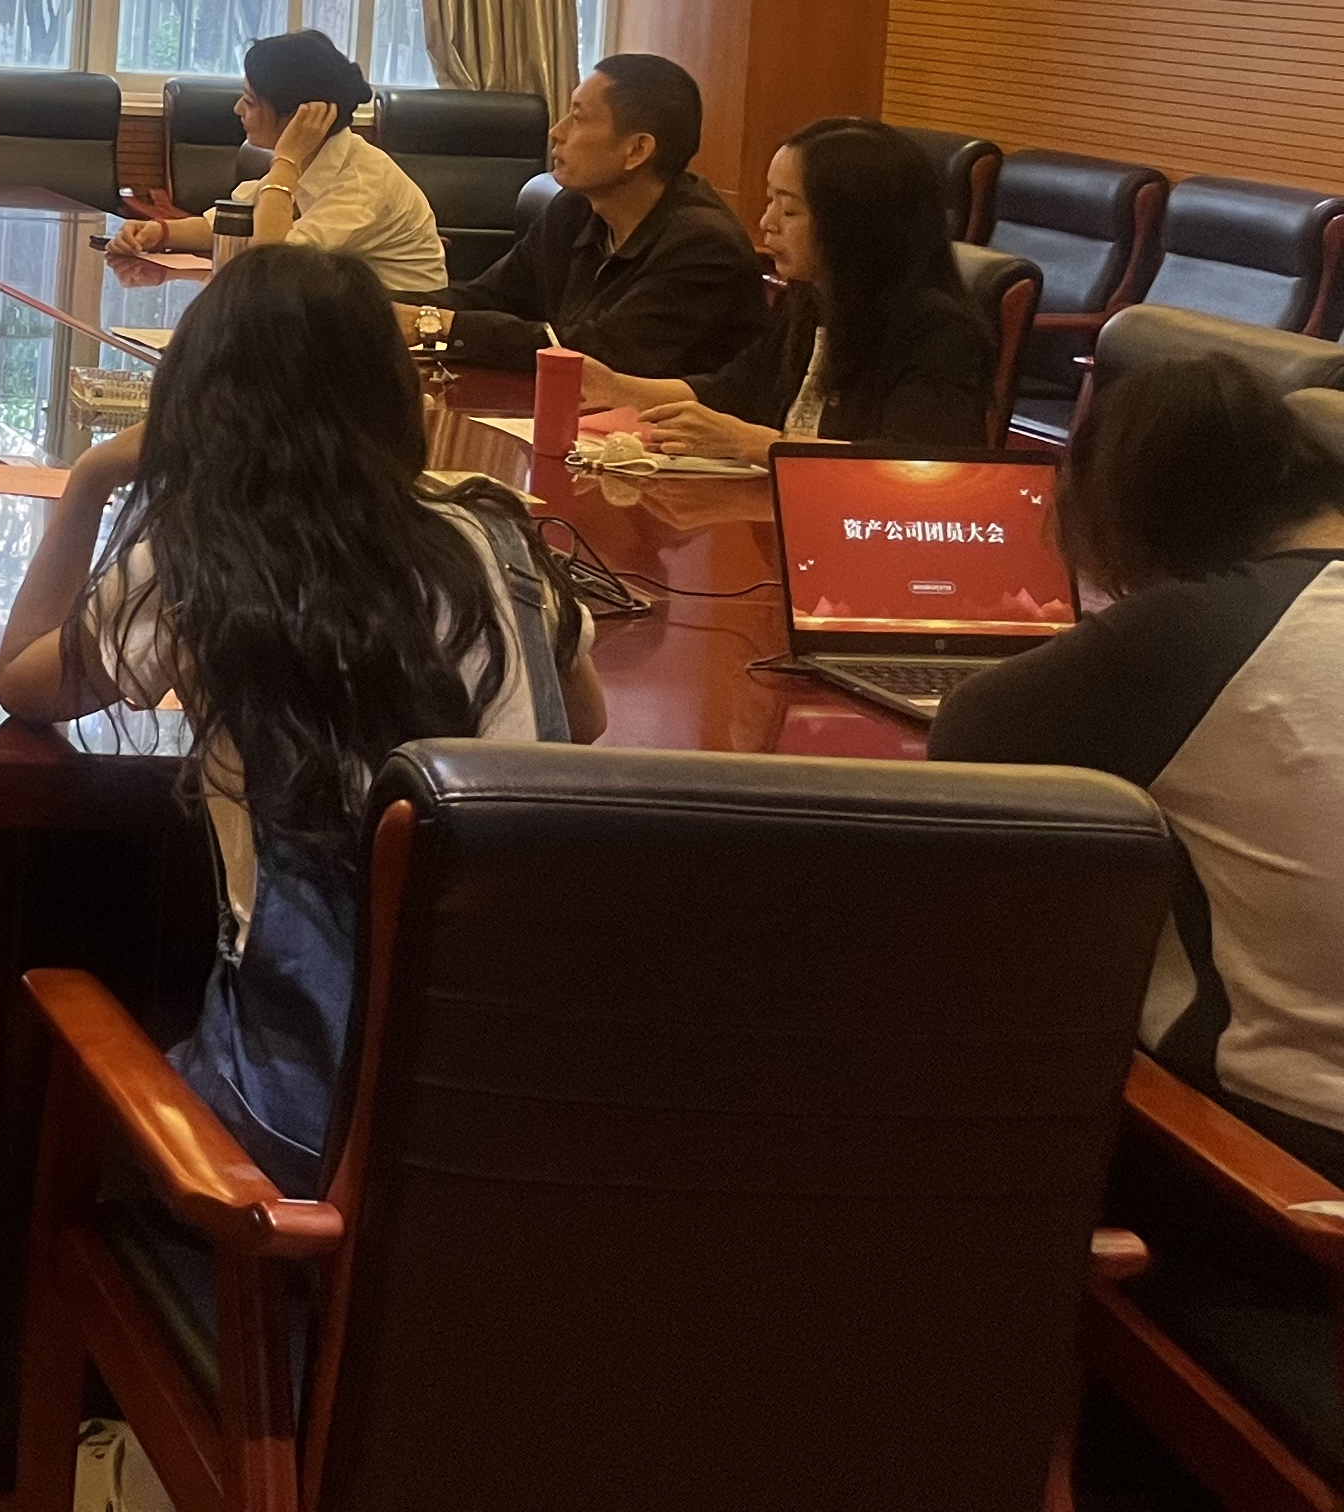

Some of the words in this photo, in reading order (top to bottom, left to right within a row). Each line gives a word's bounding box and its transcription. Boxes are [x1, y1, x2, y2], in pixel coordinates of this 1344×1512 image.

[843, 518, 1005, 544] 资产公司团员大会
